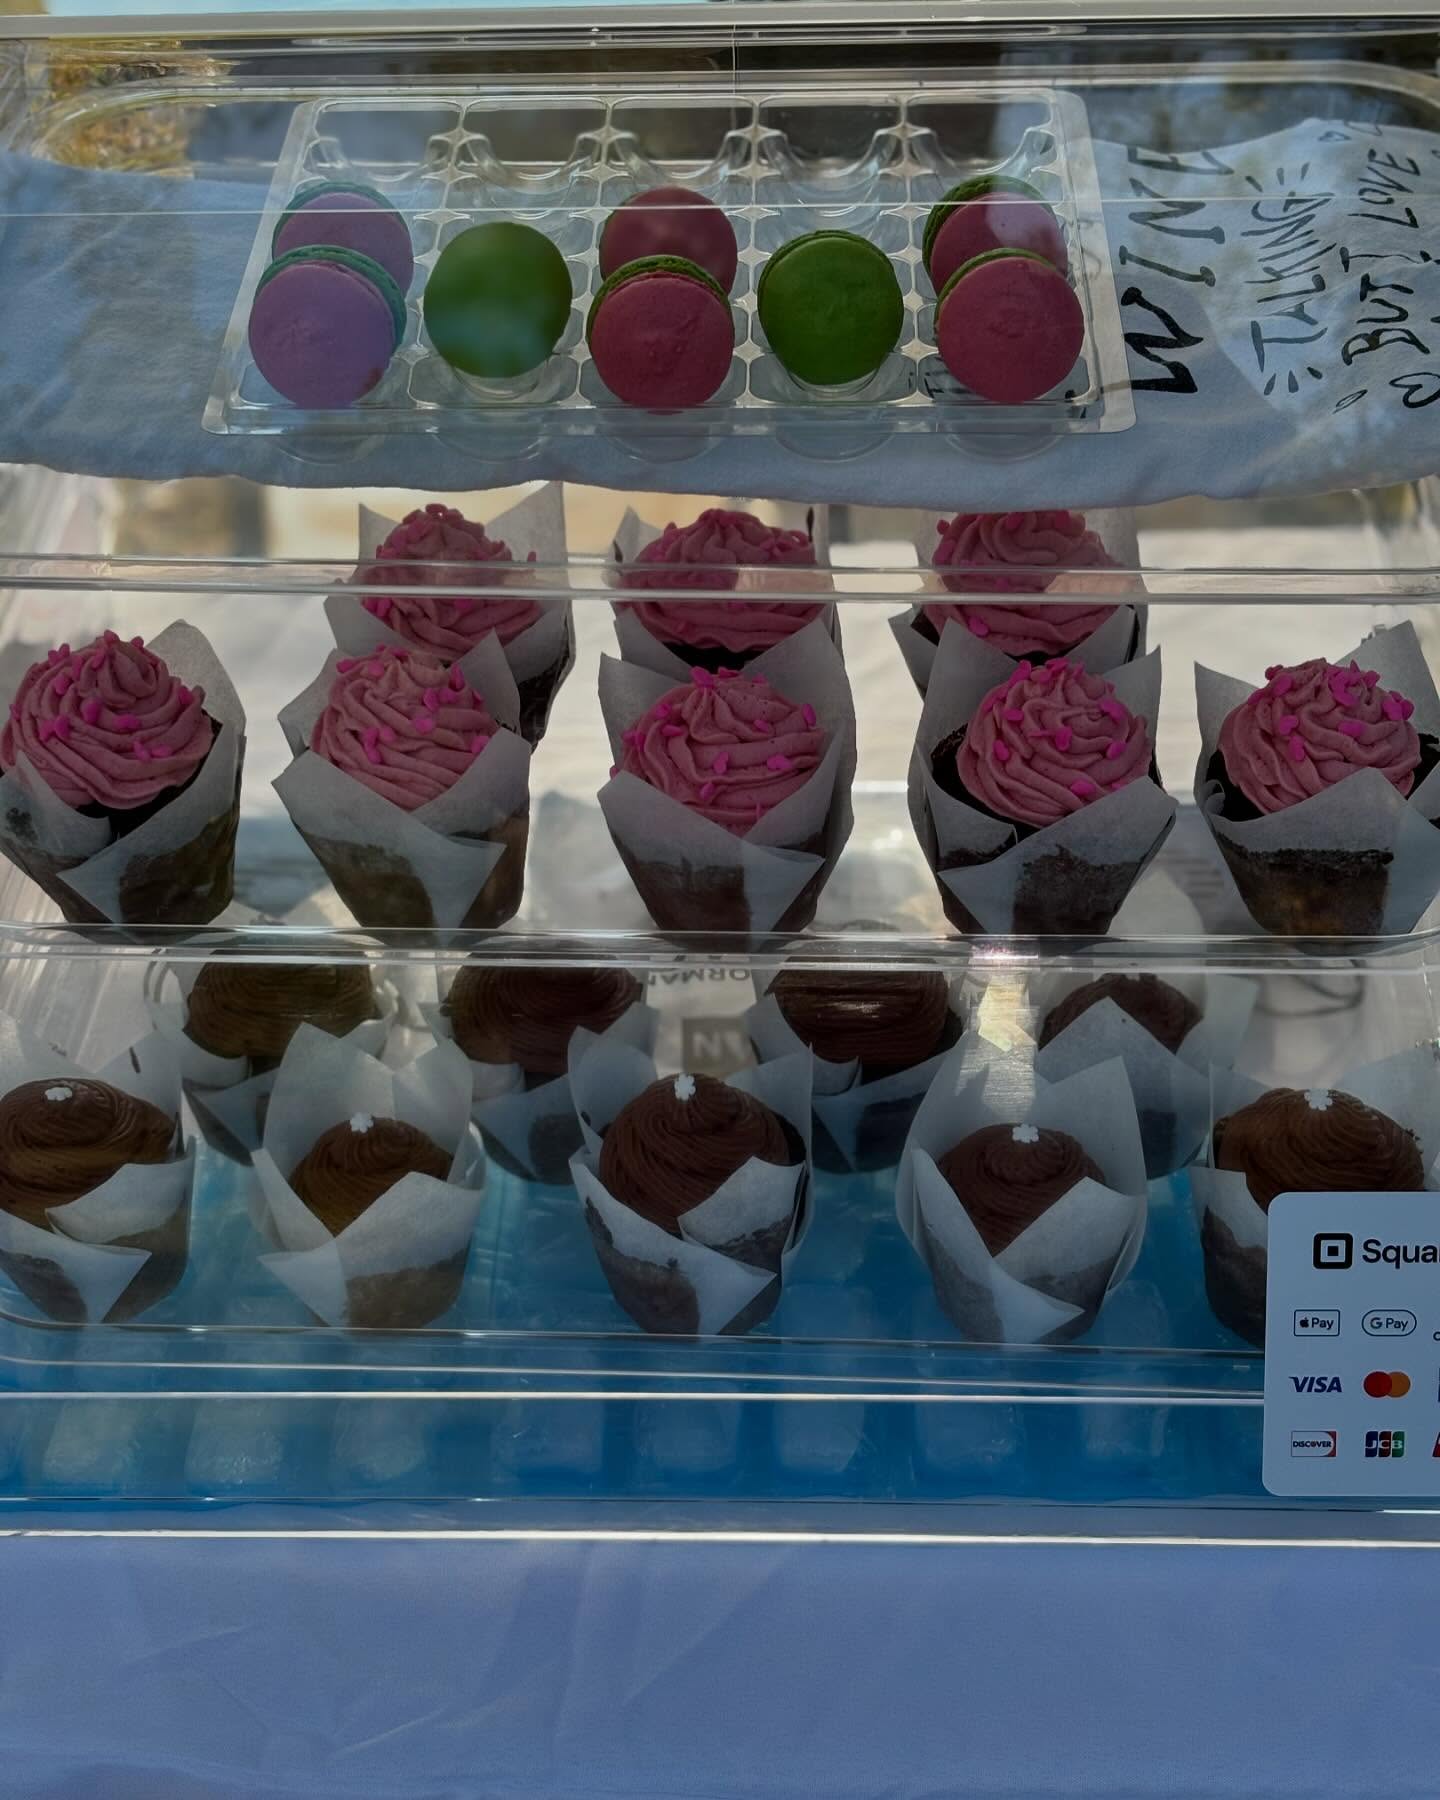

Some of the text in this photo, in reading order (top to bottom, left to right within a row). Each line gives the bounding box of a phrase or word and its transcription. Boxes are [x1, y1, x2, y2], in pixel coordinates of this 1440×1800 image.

[1347, 149, 1421, 229] LOVE
[1103, 146, 1235, 393] WINE
[1240, 191, 1337, 373] TALKING
[1341, 273, 1431, 365] BUT
[1362, 1239, 1440, 1269] Squa
[1311, 1317, 1334, 1330] Pay
[1385, 1318, 1408, 1331] Pay
[1289, 1376, 1342, 1393] VISA
[1292, 1440, 1332, 1449] DISCOVER
